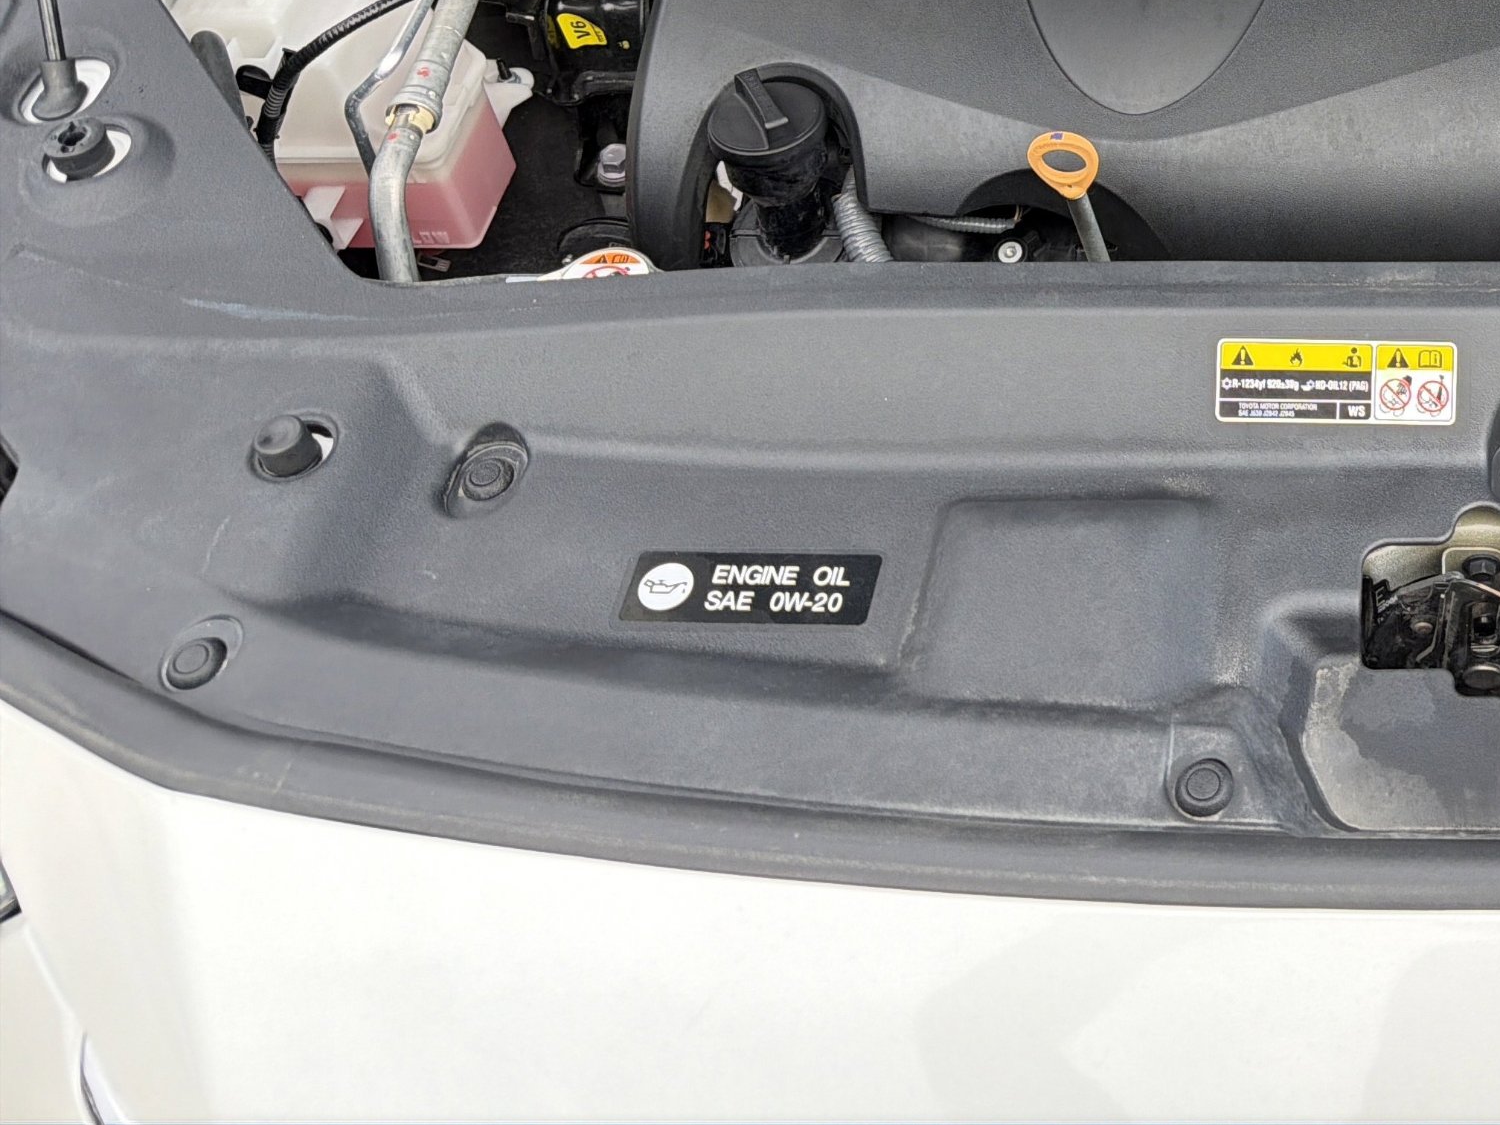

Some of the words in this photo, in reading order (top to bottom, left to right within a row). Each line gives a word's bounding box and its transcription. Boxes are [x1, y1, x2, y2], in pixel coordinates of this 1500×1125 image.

[570, 20, 592, 40] V6
[1238, 402, 1260, 410] TOYOTA
[1259, 402, 1280, 410] MOTOR
[1279, 402, 1318, 411] CORPORATION
[1347, 404, 1366, 417] WS
[711, 564, 800, 586] ENGINE
[812, 566, 851, 587] OIL
[704, 590, 755, 612] SAE
[768, 591, 844, 613] 0W-20
